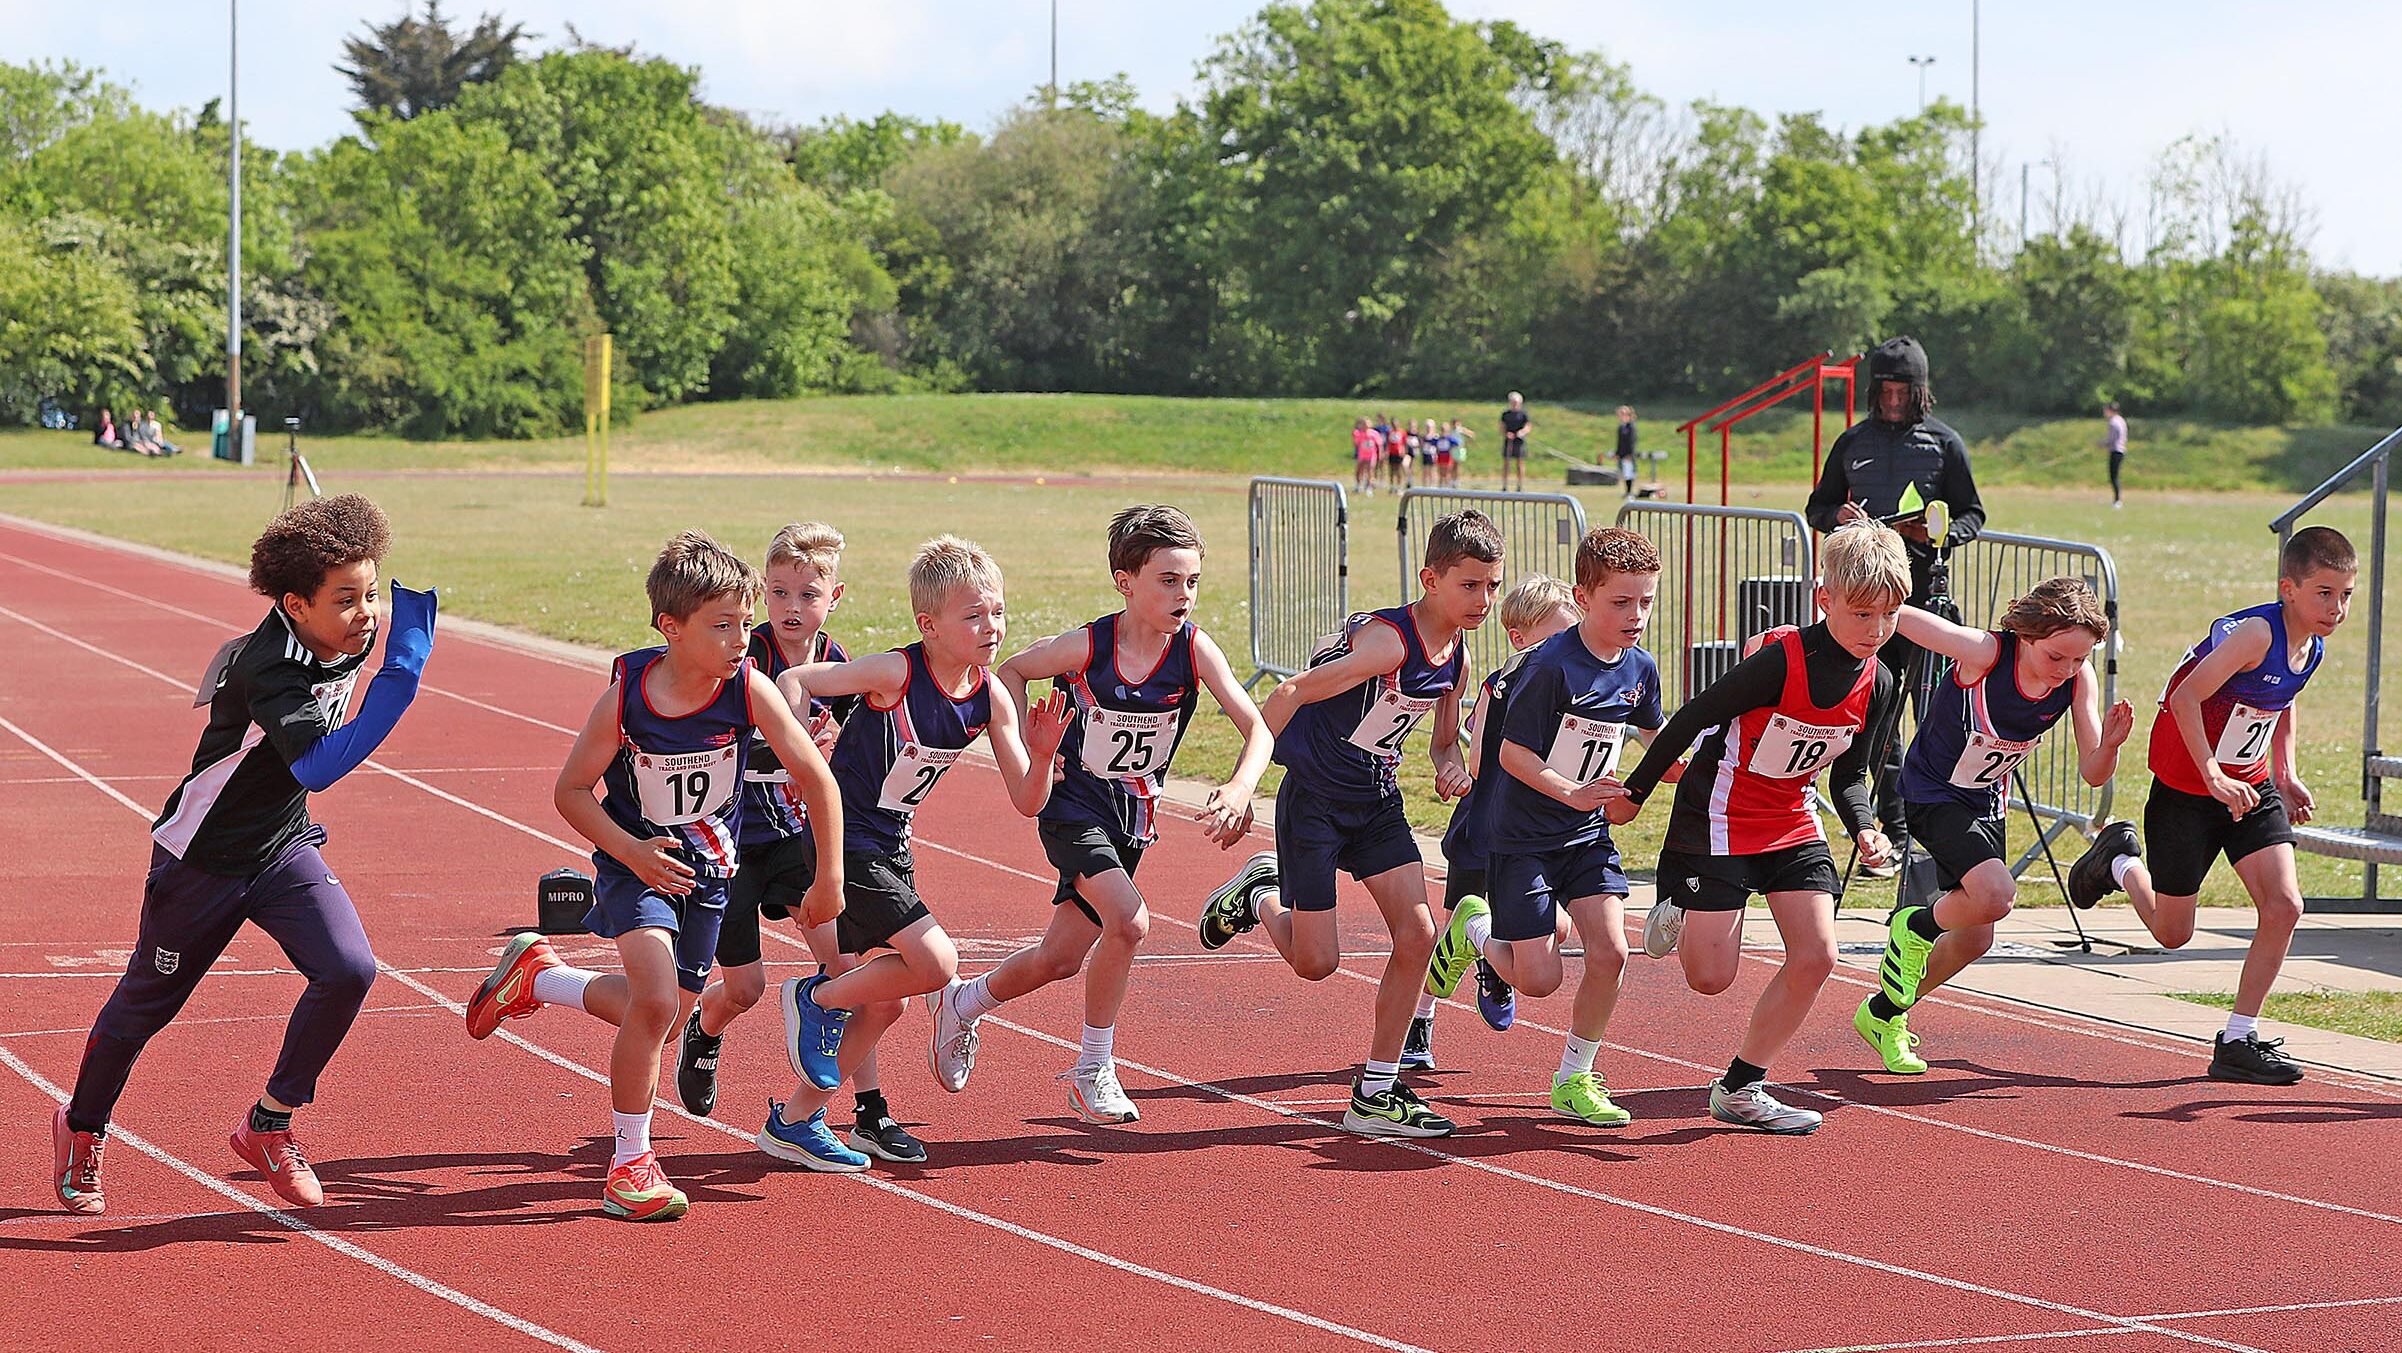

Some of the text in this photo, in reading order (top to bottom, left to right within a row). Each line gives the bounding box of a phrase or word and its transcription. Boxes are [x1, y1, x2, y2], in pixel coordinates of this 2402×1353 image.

[1117, 714, 1158, 724] SOUTHEND
[1797, 724, 1836, 736] SOUTHEND
[2236, 720, 2272, 758] 21
[664, 754, 711, 766] SOUTHEND
[1107, 730, 1158, 773] 25
[1577, 739, 1613, 782] 17
[1784, 739, 1828, 773] 18
[665, 771, 710, 817] 19
[547, 891, 585, 902] MIPRO
[694, 1057, 718, 1070] NIKE
